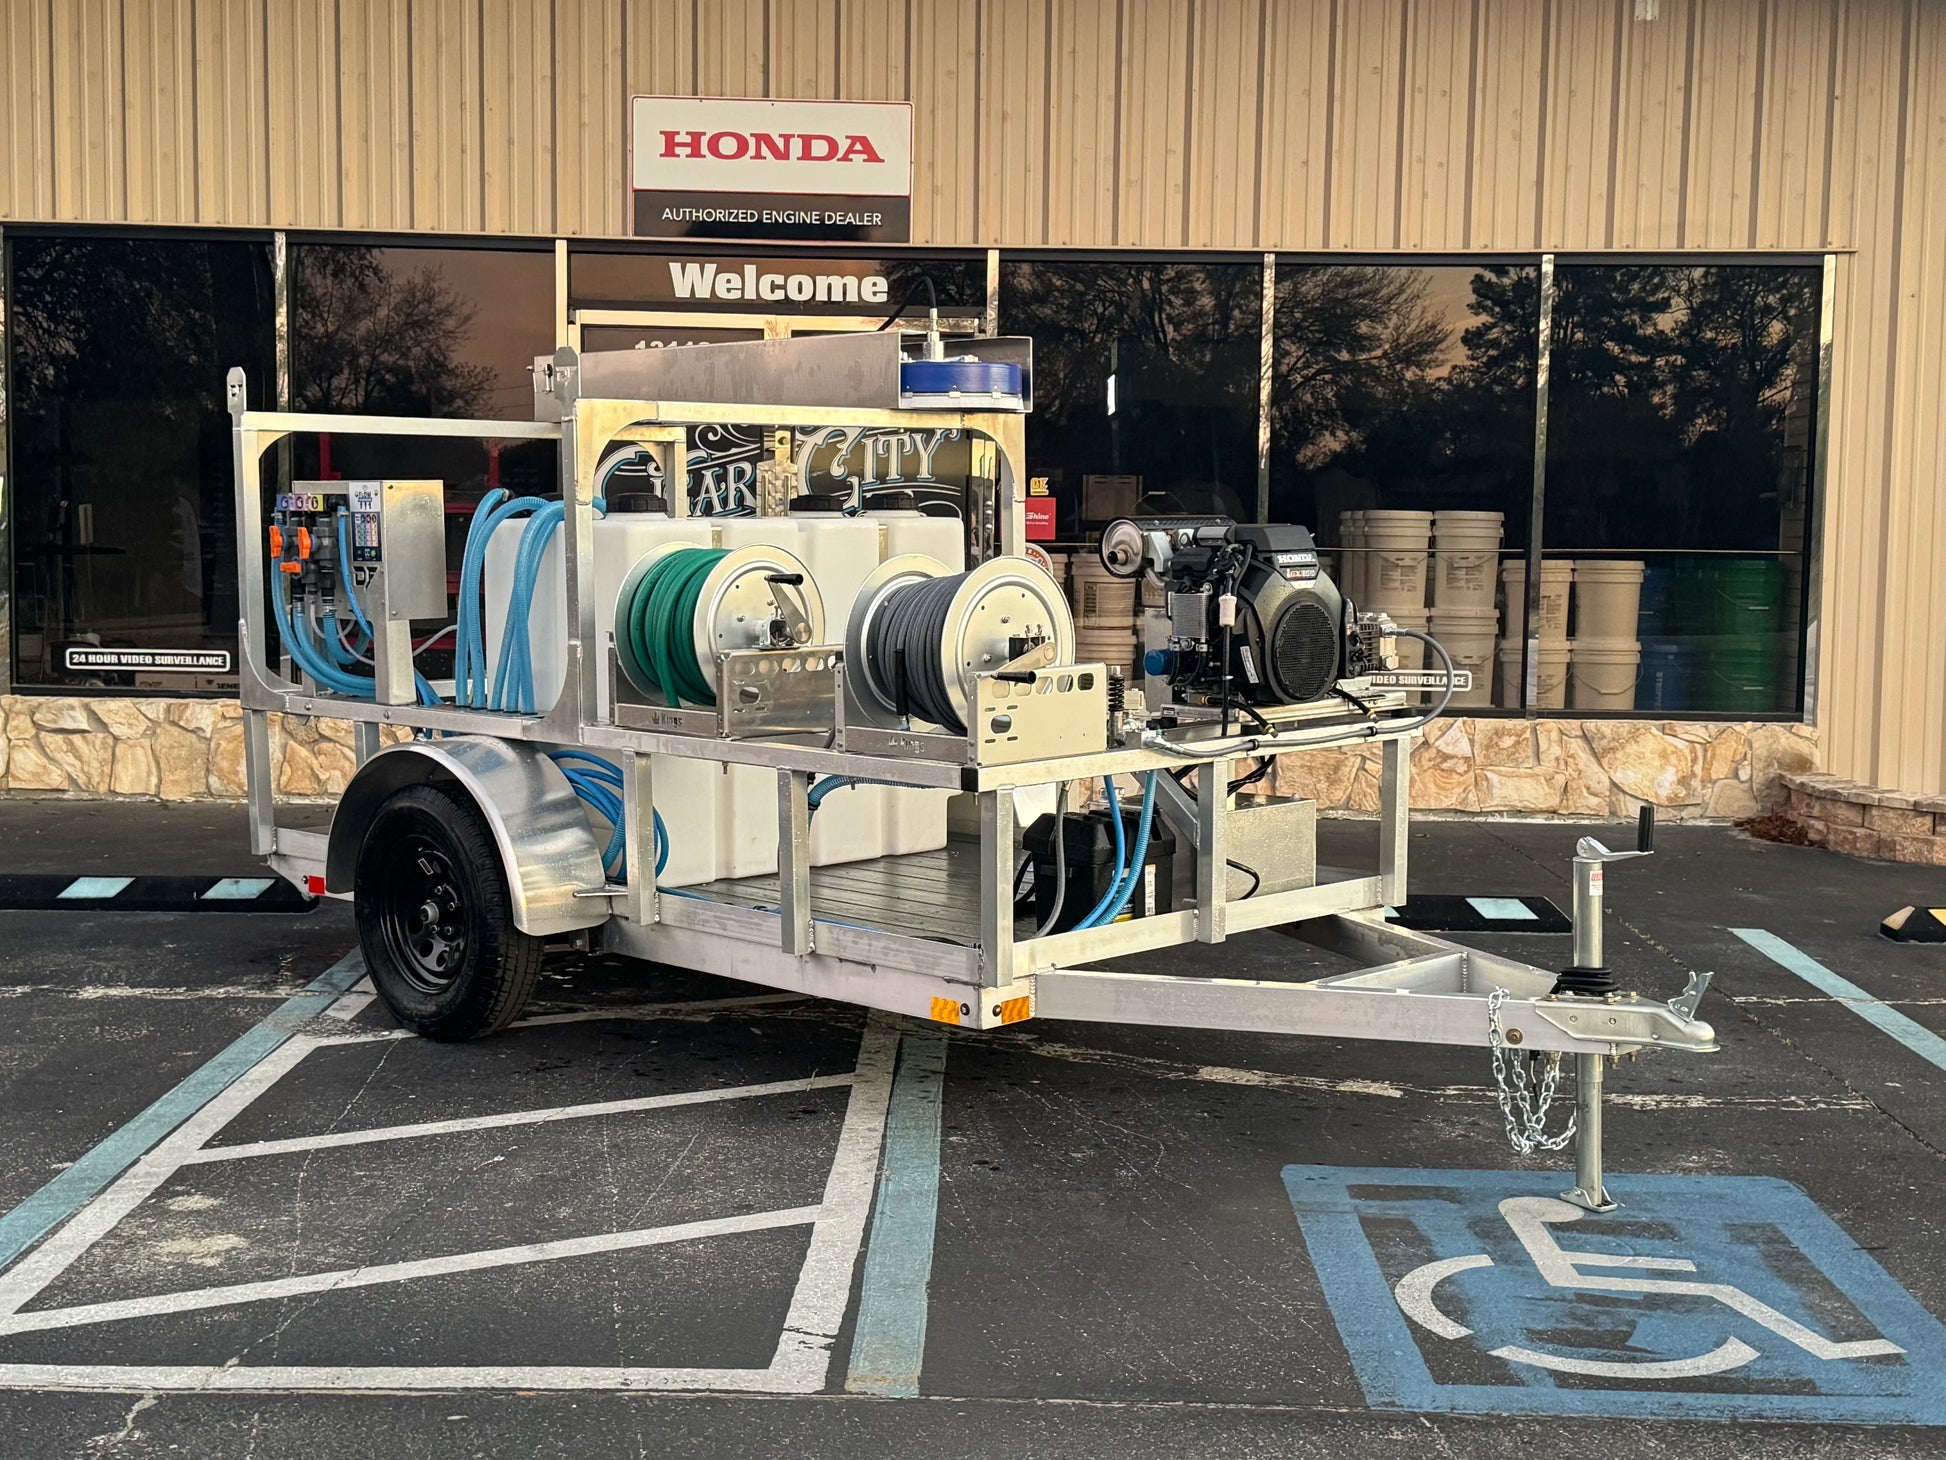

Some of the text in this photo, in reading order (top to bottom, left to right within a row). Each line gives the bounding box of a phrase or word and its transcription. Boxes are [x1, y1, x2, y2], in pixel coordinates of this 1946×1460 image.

[659, 130, 885, 163] HONDA
[661, 207, 882, 226] AUTHORIZED ENGINE DEALER
[668, 262, 889, 302] Welcome
[72, 654, 225, 666] 24 HOUR VIDEO SURVEILLANCE
[1371, 675, 1466, 686] IDEO SURVEILLACE
